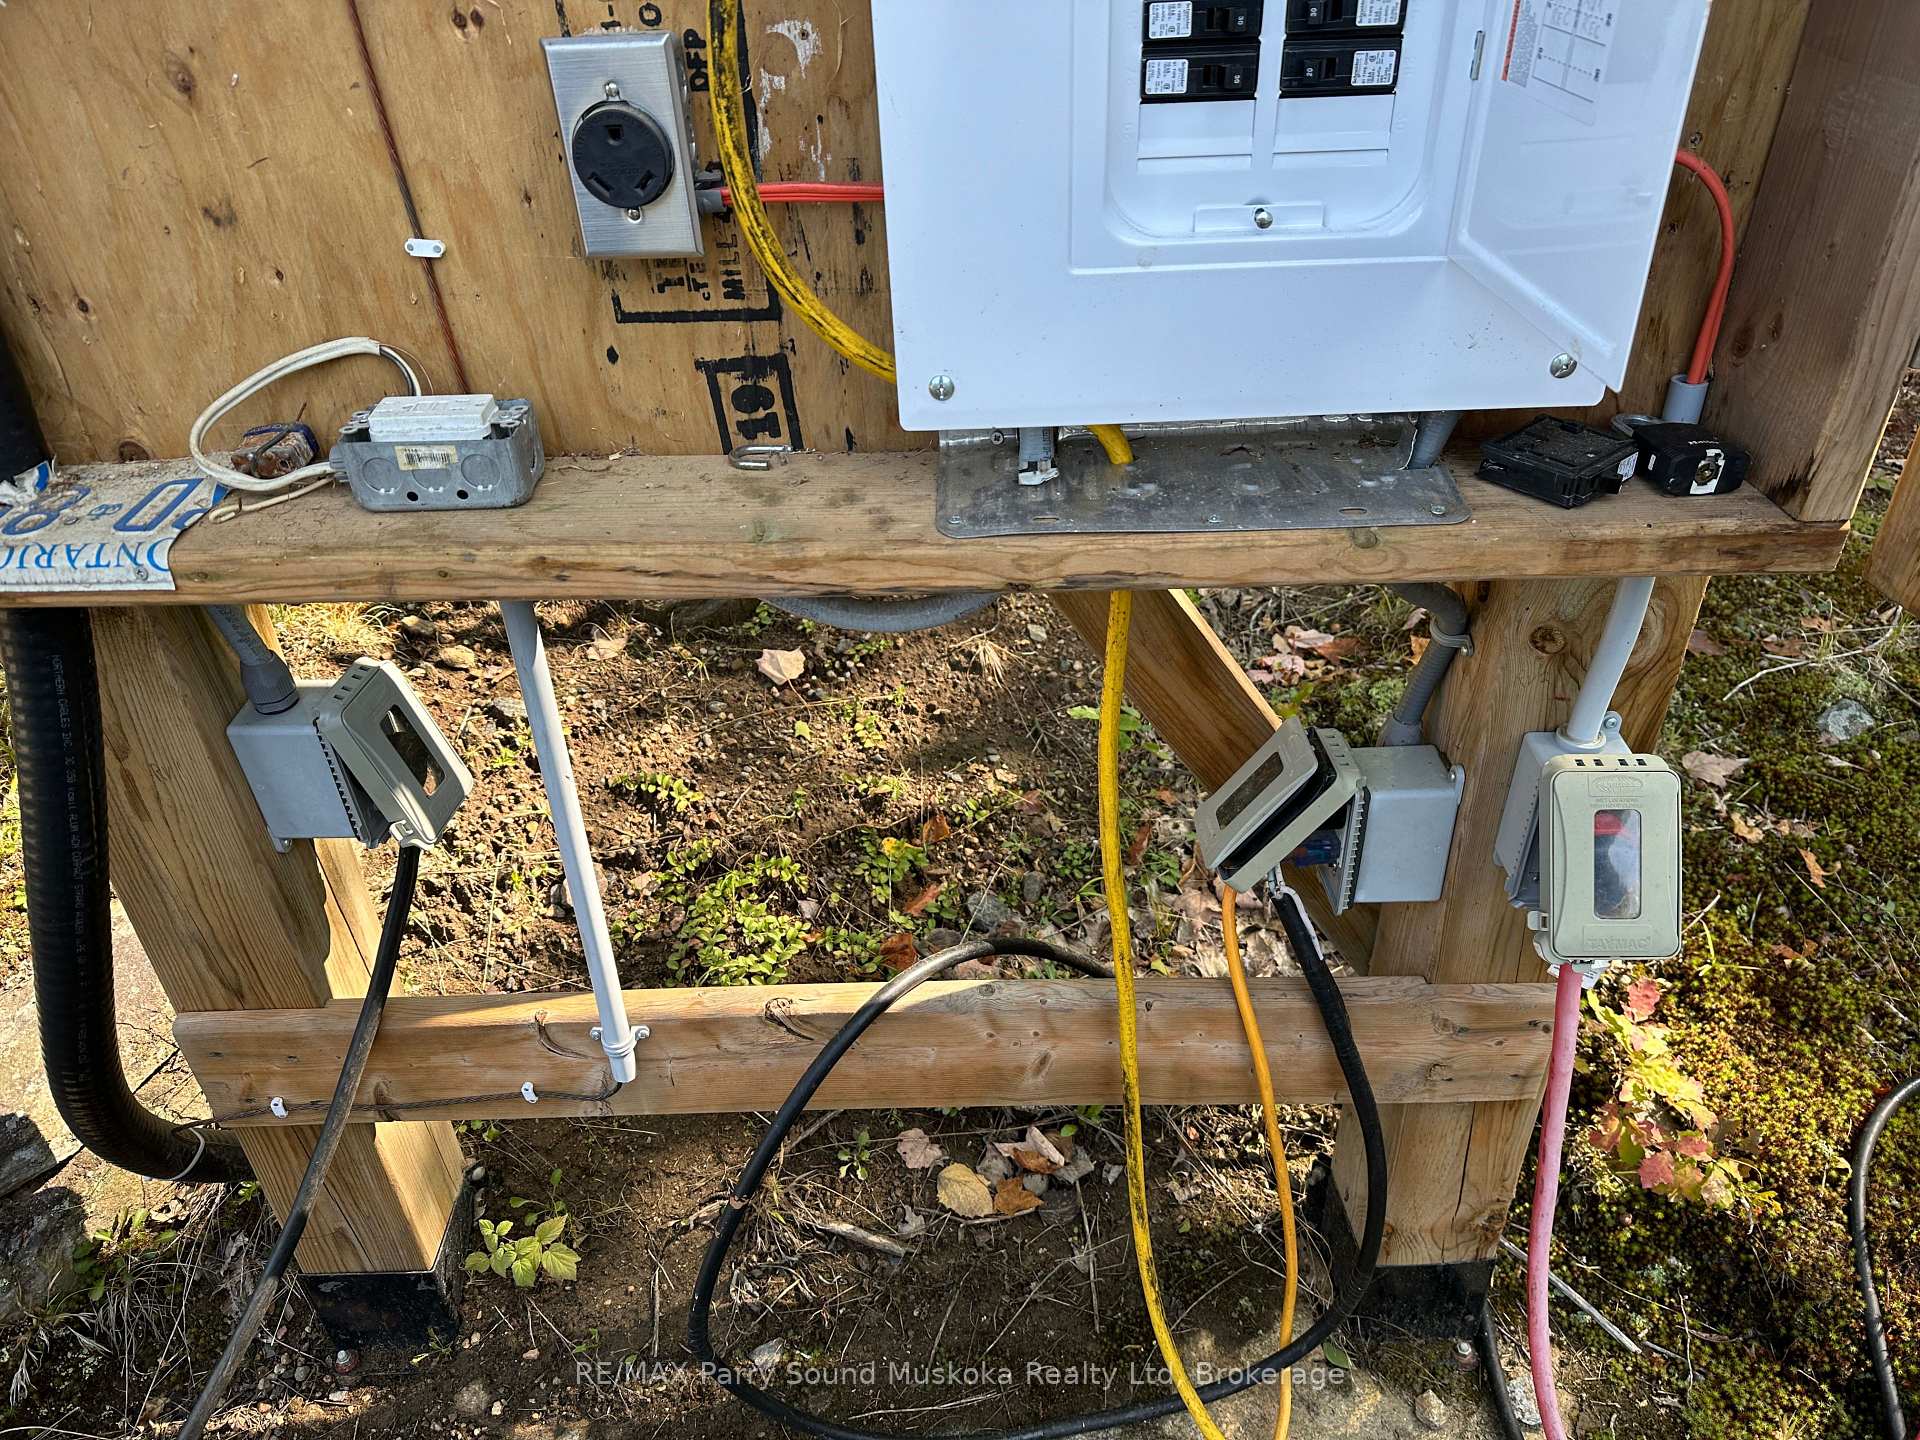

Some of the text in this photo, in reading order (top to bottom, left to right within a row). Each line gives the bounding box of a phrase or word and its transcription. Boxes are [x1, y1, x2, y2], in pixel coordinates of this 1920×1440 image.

[1305, 67, 1313, 78] 20
[716, 234, 746, 300] MILL
[731, 384, 781, 441] 19
